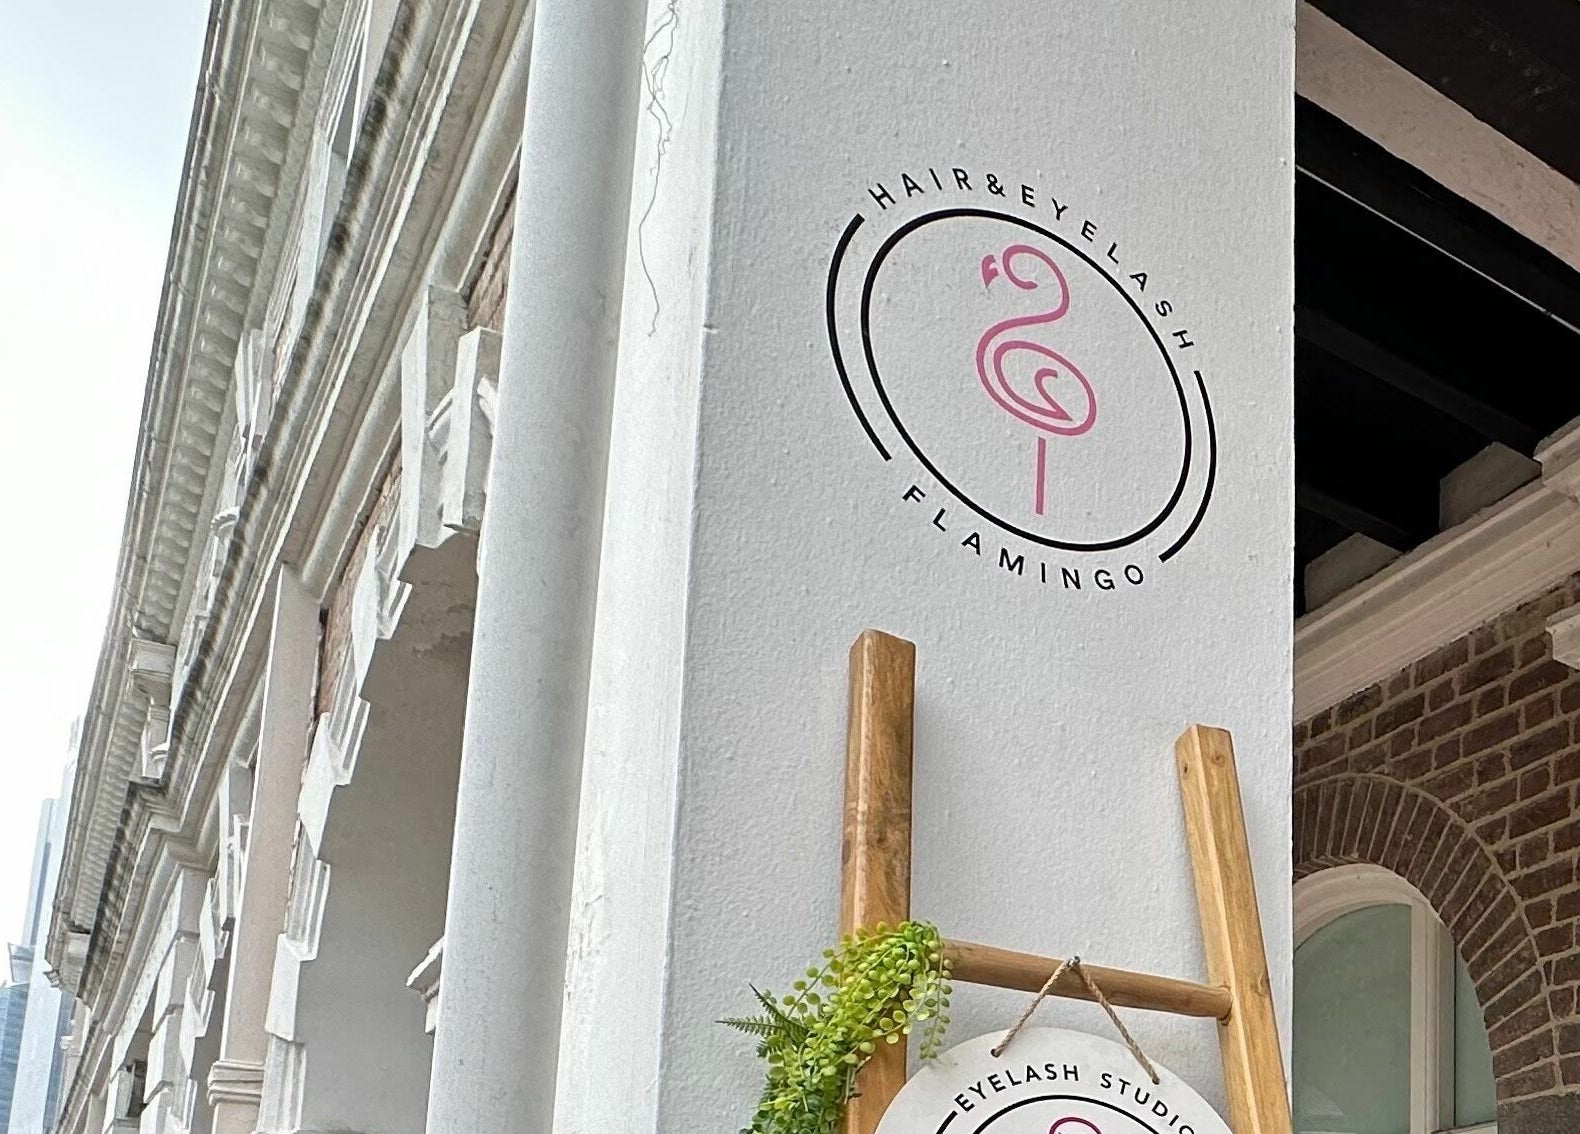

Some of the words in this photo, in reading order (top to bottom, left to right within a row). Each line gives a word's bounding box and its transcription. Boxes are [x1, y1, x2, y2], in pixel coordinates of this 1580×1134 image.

[868, 168, 1194, 349] HAIR&EYELASH
[903, 484, 1144, 590] FLAMINGO
[954, 1063, 1079, 1113] EYELASH
